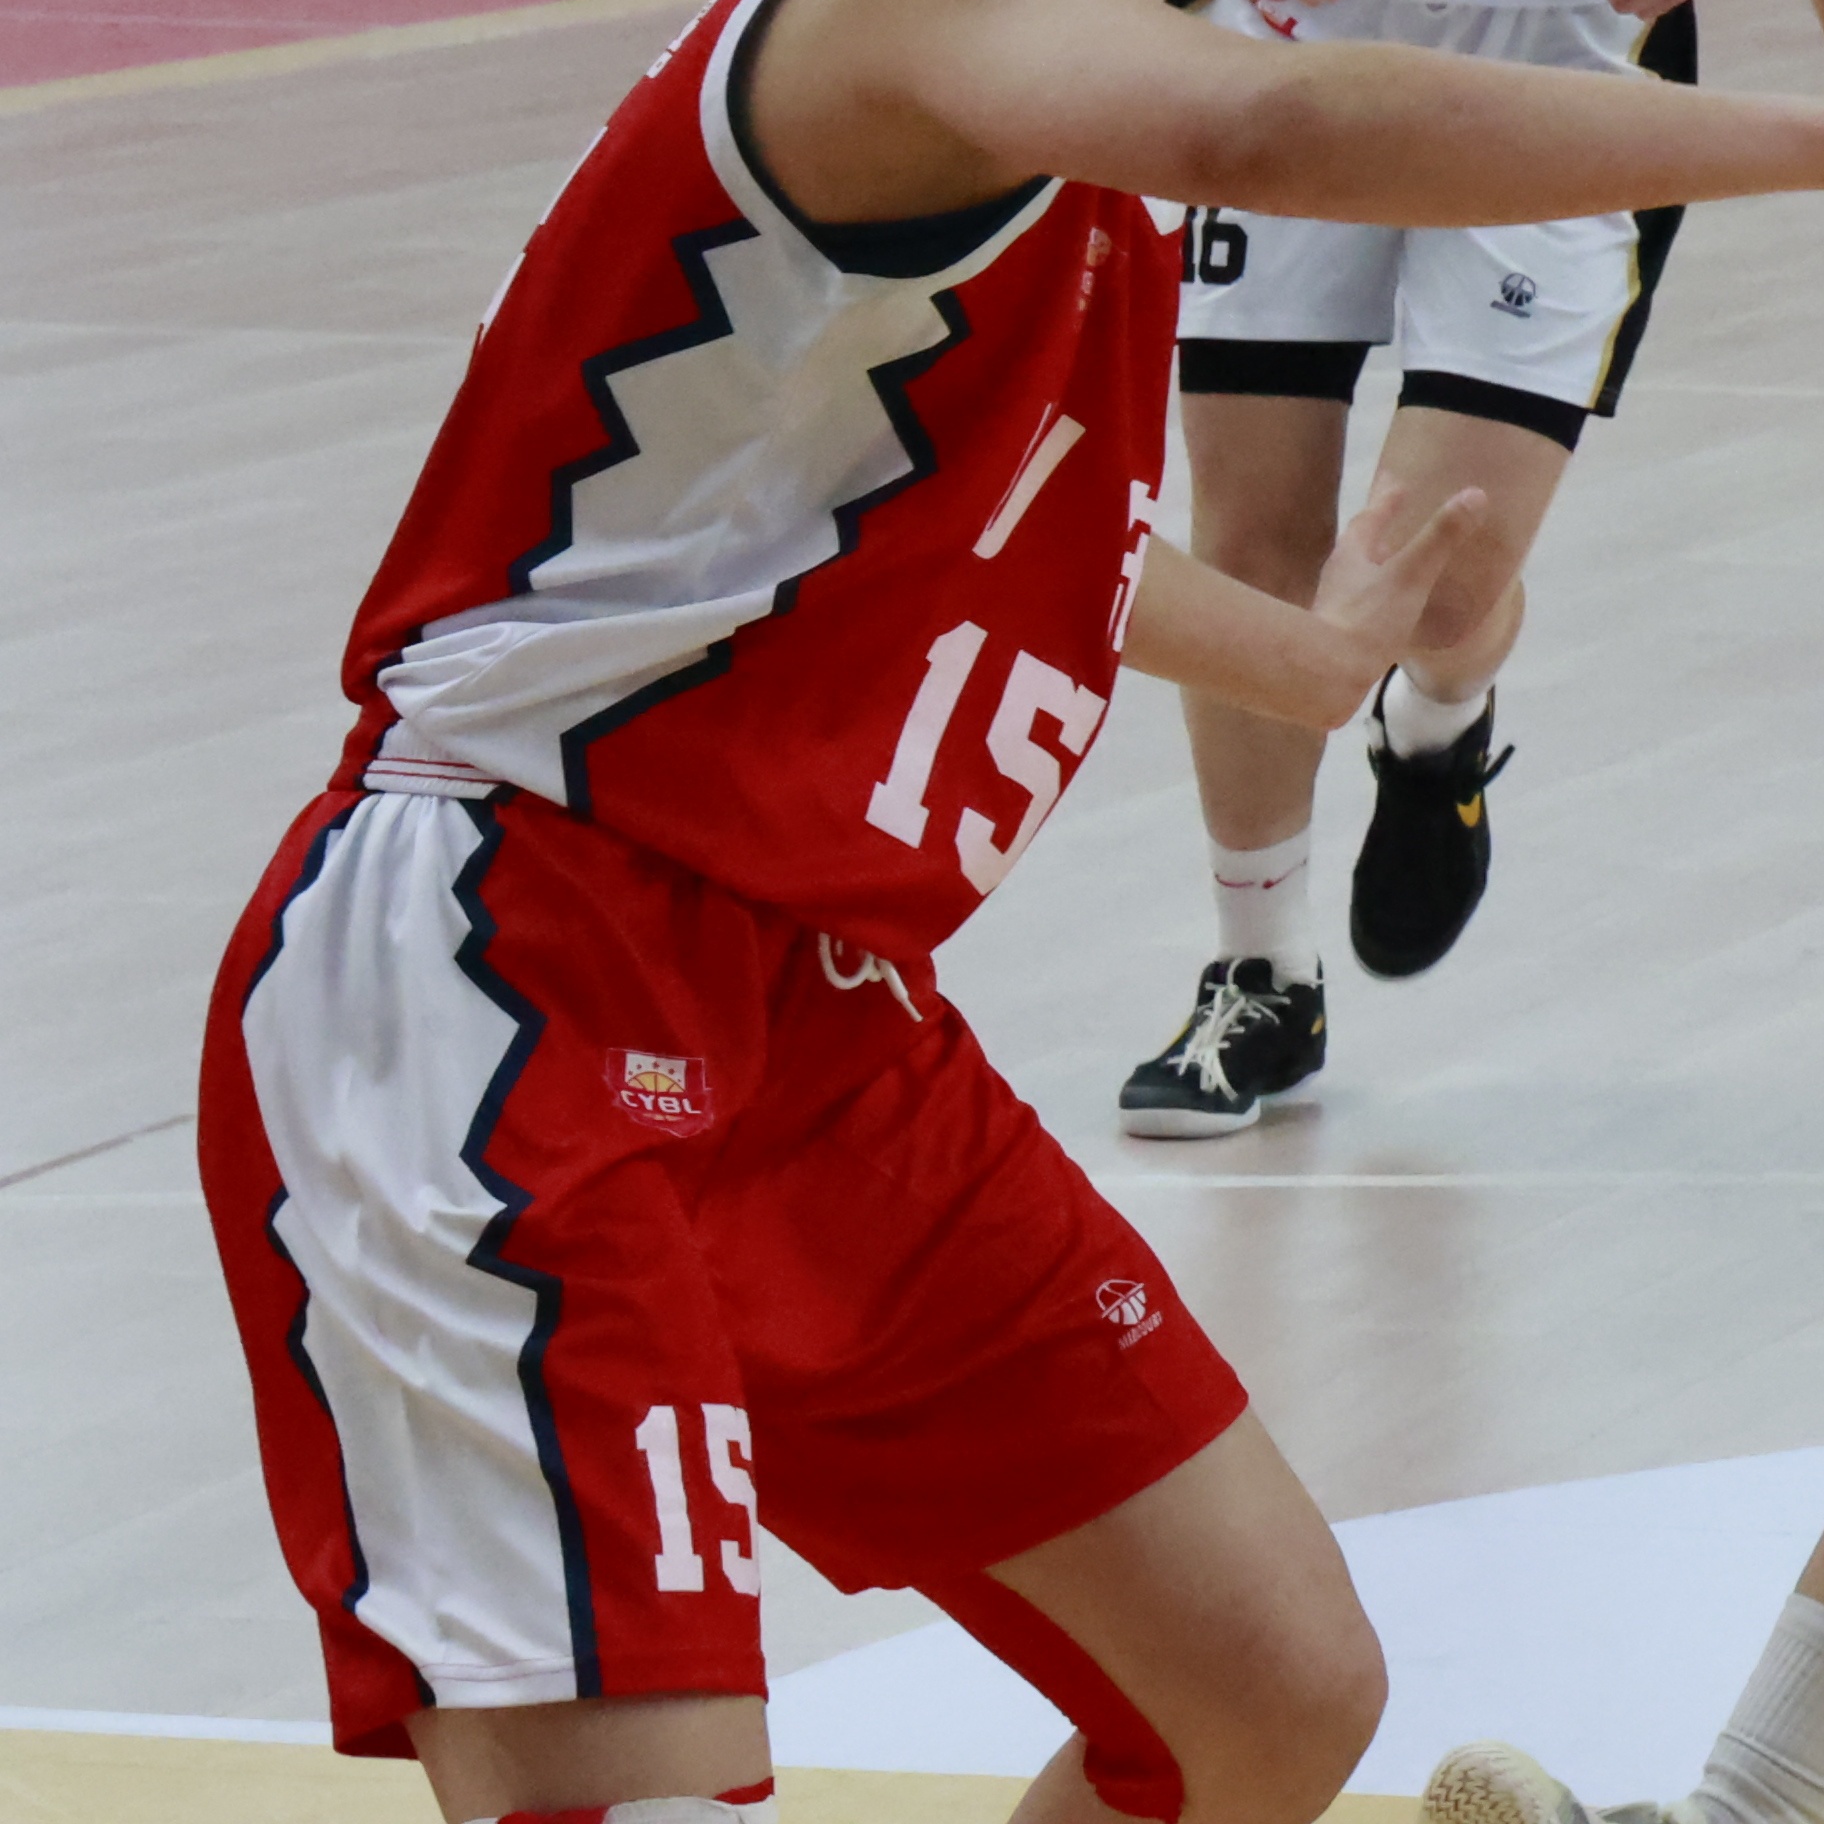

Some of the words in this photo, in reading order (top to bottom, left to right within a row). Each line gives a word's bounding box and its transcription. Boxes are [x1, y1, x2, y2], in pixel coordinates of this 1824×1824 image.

[865, 620, 1108, 897] 15
[620, 1089, 702, 1114] CYBL
[635, 1404, 760, 1597] 15
